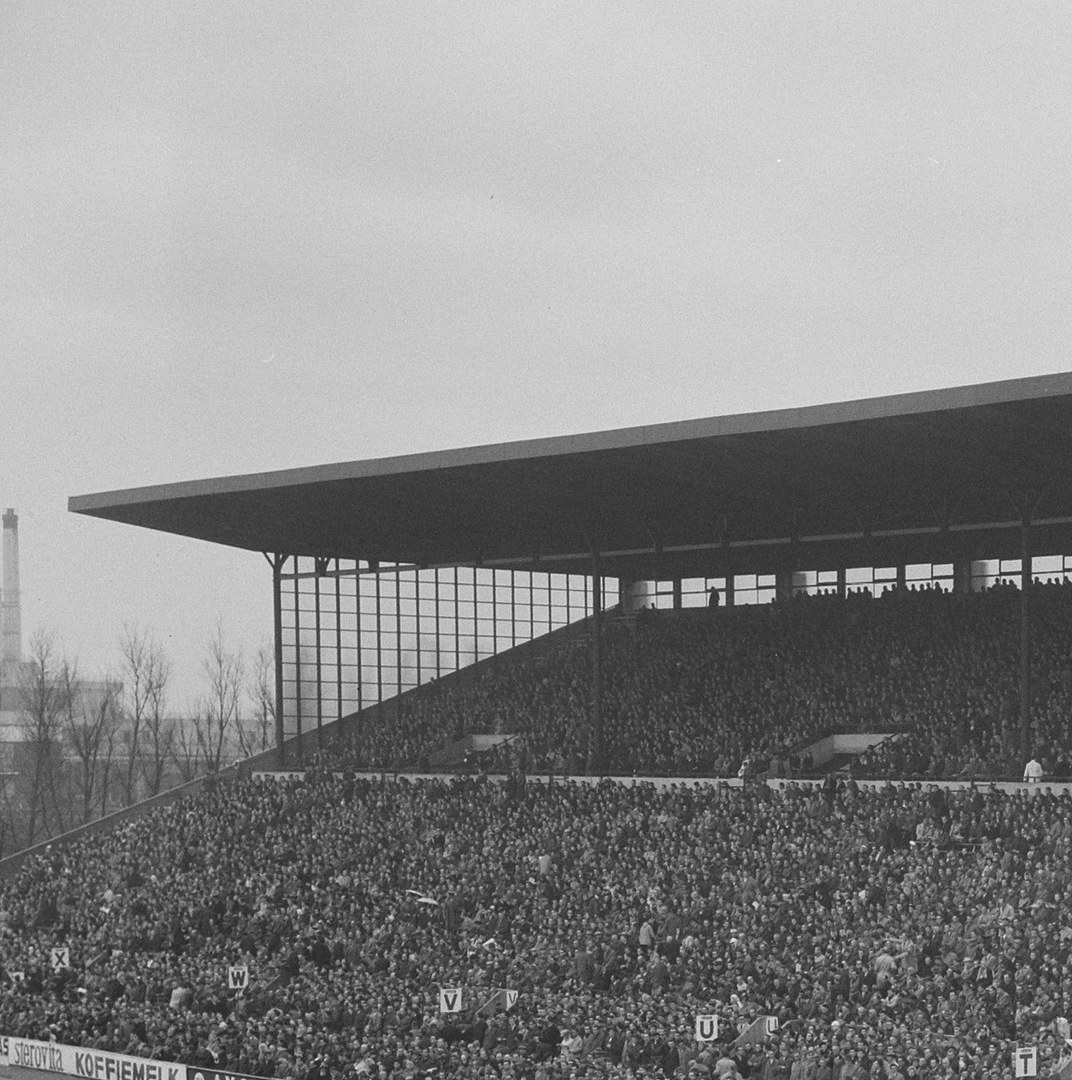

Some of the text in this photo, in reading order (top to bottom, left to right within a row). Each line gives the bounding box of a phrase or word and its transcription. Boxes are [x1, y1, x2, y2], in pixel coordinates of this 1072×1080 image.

[55, 952, 65, 966] X
[231, 971, 246, 987] W
[444, 994, 458, 1011] V
[700, 1020, 714, 1039] U
[1019, 1053, 1033, 1075] T
